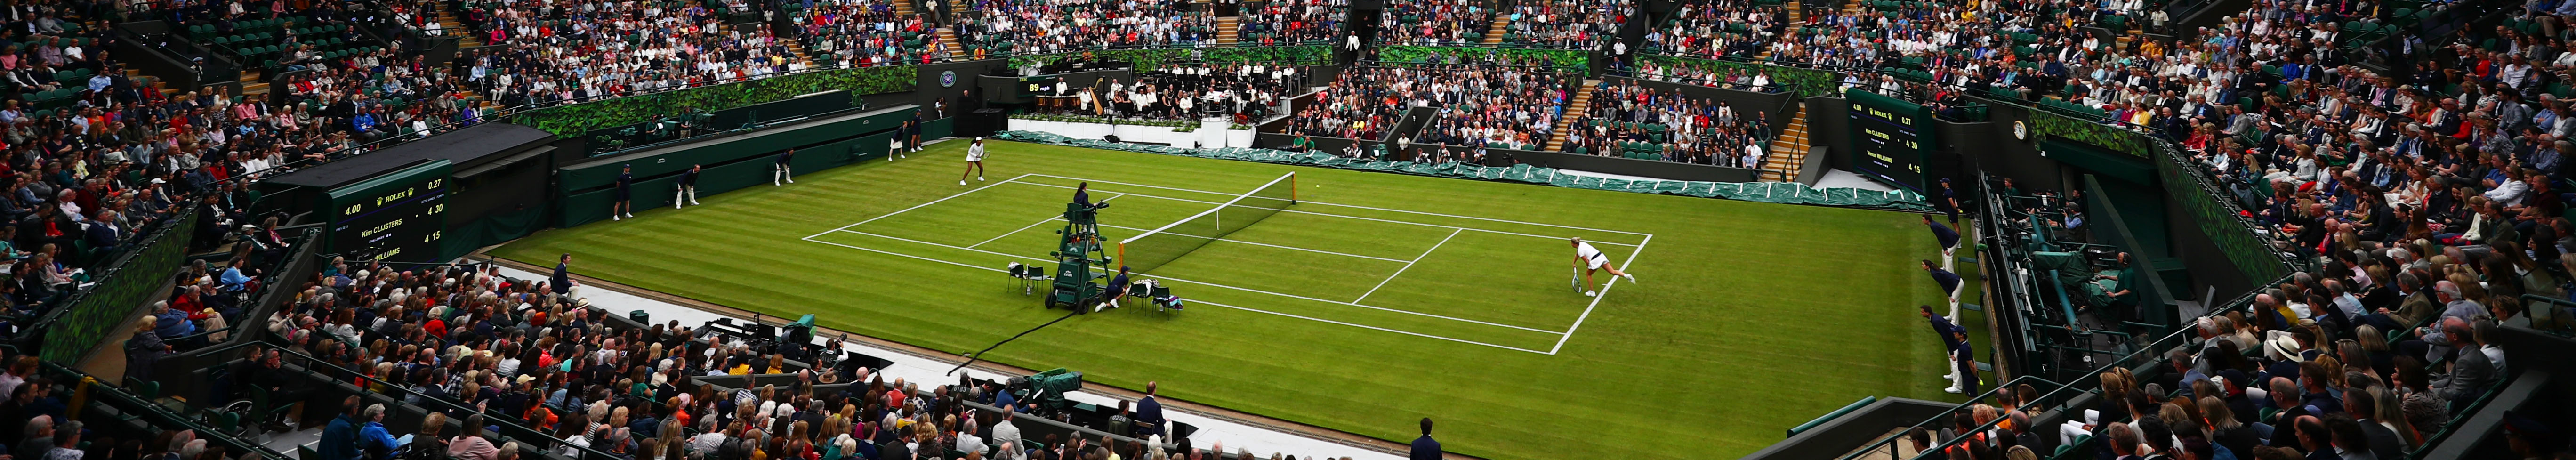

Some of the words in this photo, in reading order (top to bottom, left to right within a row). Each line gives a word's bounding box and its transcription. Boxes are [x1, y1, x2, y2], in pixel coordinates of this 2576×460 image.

[1029, 84, 1039, 92] 89
[1901, 117, 1911, 125] 0.27
[1911, 141, 1917, 150] 30
[1876, 153, 1892, 163] WILLIAMS
[1914, 165, 1920, 174] 15
[345, 204, 361, 216] 4.00
[385, 191, 406, 203] ROLEX
[428, 178, 441, 189] 0.27
[362, 229, 372, 238] Kim
[373, 218, 402, 234] CLIJSTERS
[427, 207, 432, 216] 4
[435, 203, 443, 213] 30
[374, 247, 400, 261] WILLIAMS
[424, 234, 429, 243] 4
[433, 230, 441, 241] 15
